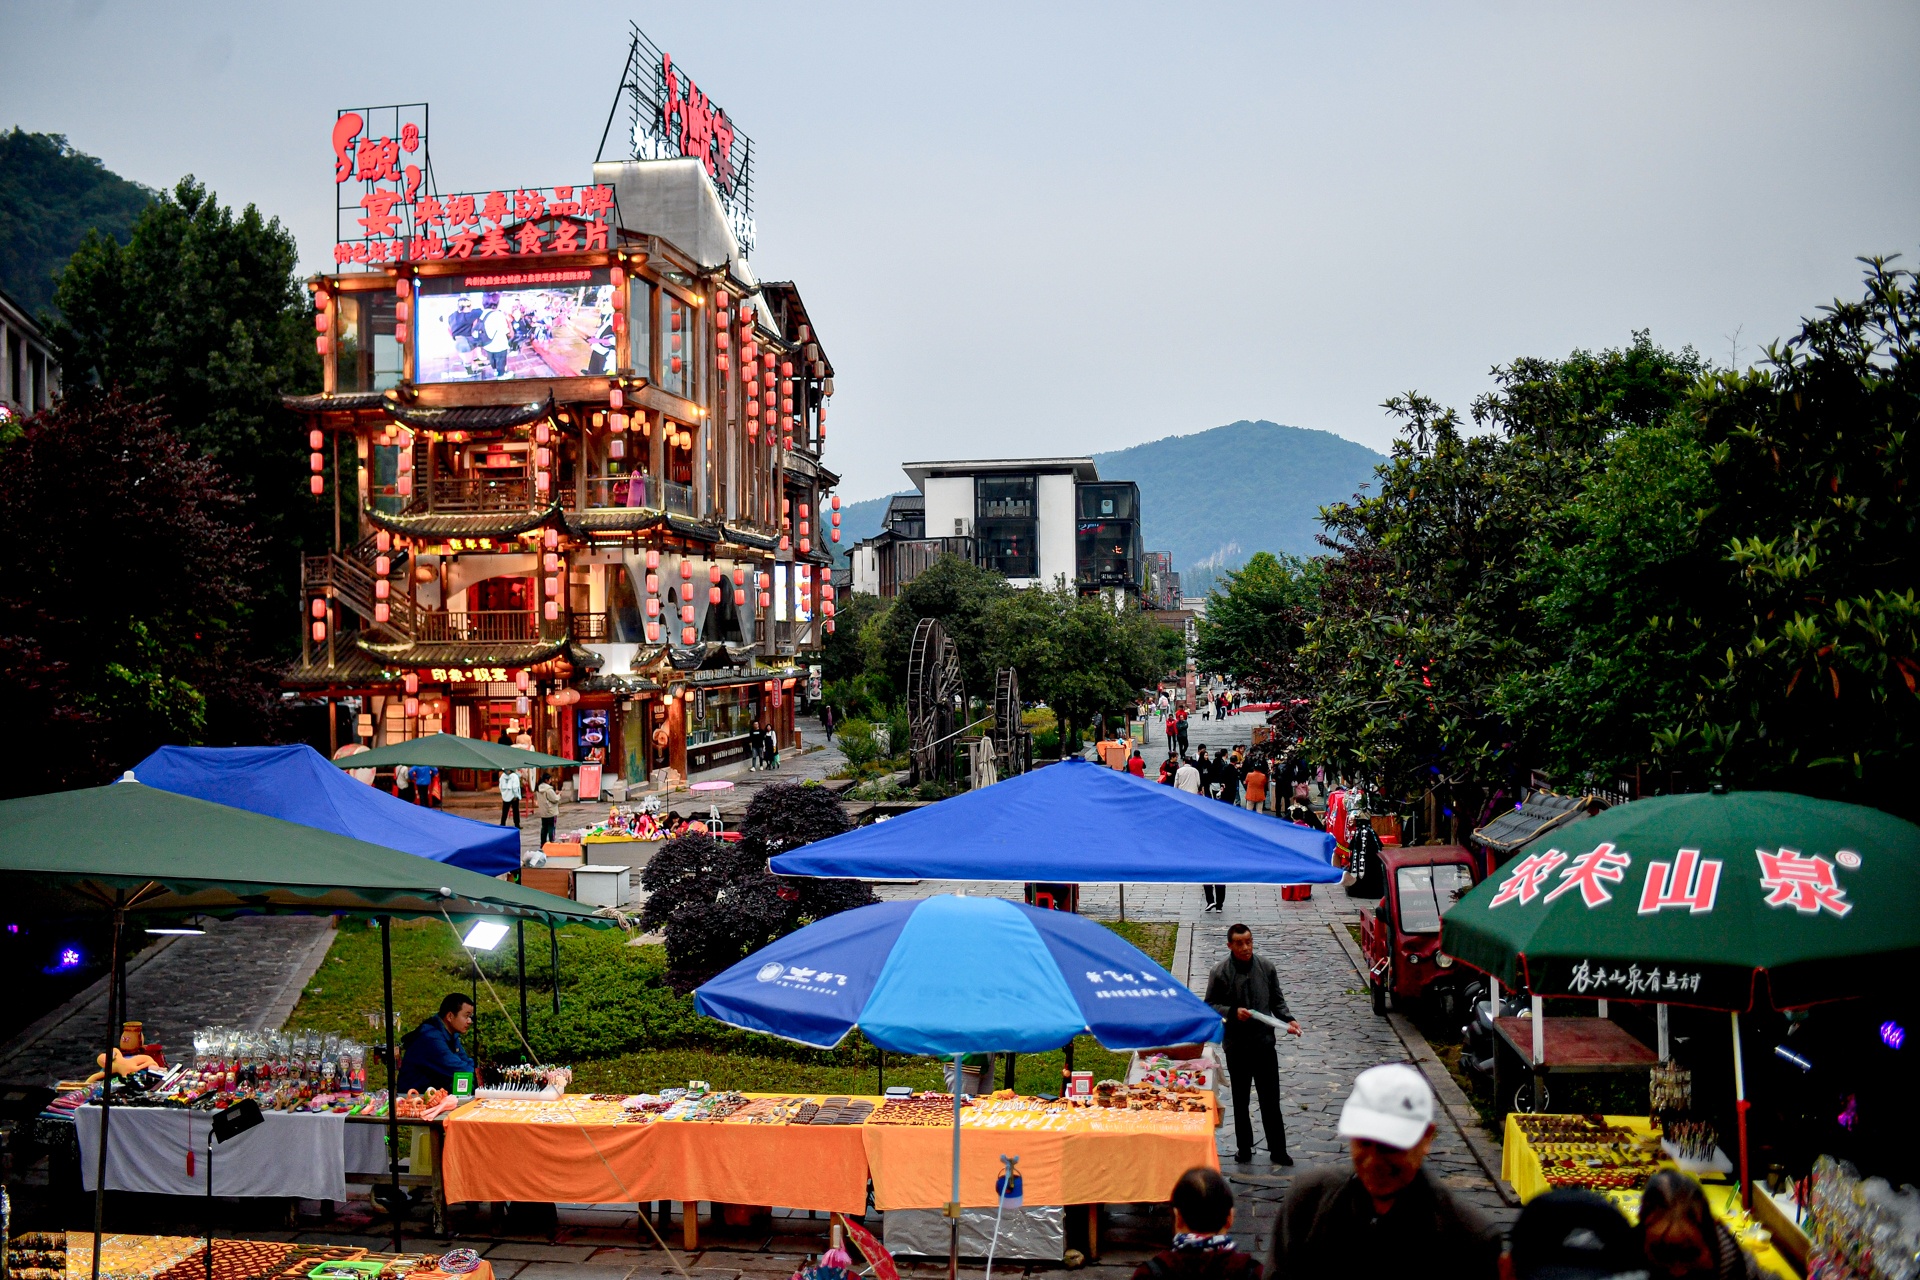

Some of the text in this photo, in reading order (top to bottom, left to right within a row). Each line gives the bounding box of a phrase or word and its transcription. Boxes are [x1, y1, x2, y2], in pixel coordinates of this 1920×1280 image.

[1489, 843, 1854, 919] 农夫山泉
[1567, 959, 1702, 994] 农夫山泉有点甜
